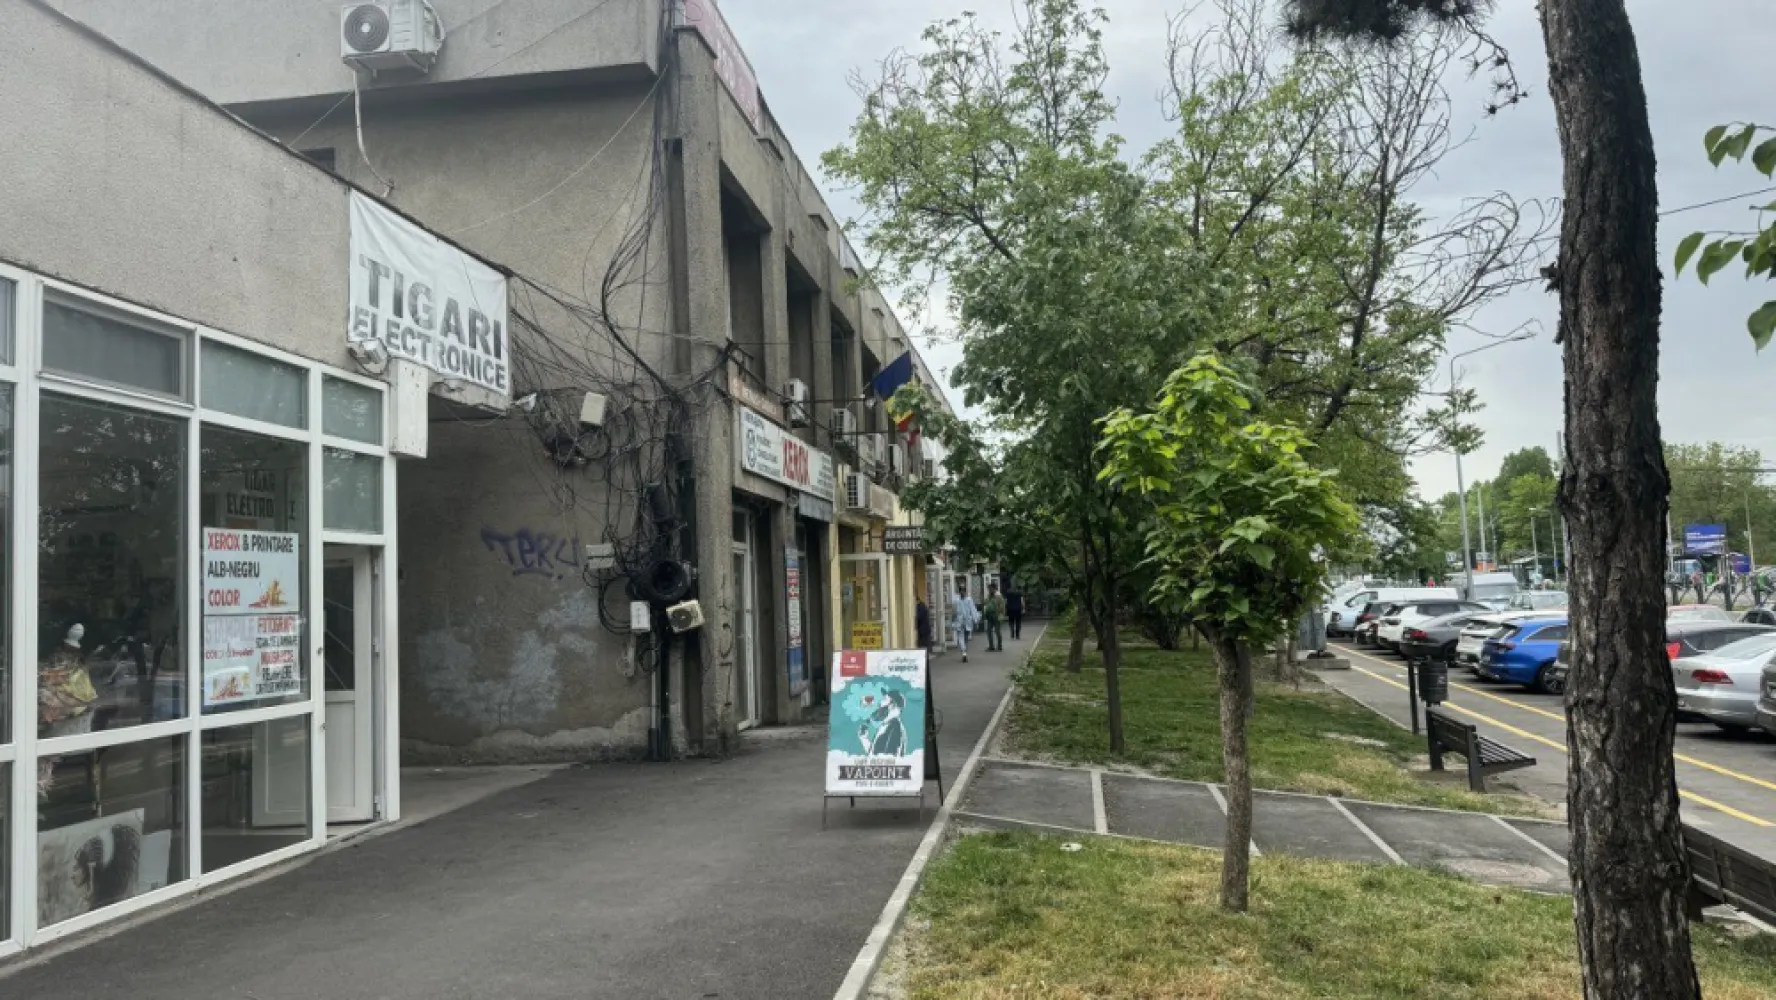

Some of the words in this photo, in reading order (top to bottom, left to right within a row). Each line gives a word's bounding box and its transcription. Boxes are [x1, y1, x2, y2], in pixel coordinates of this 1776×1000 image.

[359, 253, 502, 360] TIGARI
[353, 304, 507, 390] ELECTRONICE
[207, 532, 240, 552] XEROX
[251, 534, 294, 553] PRINTARE
[207, 560, 260, 578] ALB-NEGRU
[208, 589, 240, 607] COLOR
[844, 766, 905, 779] VAPOINT
